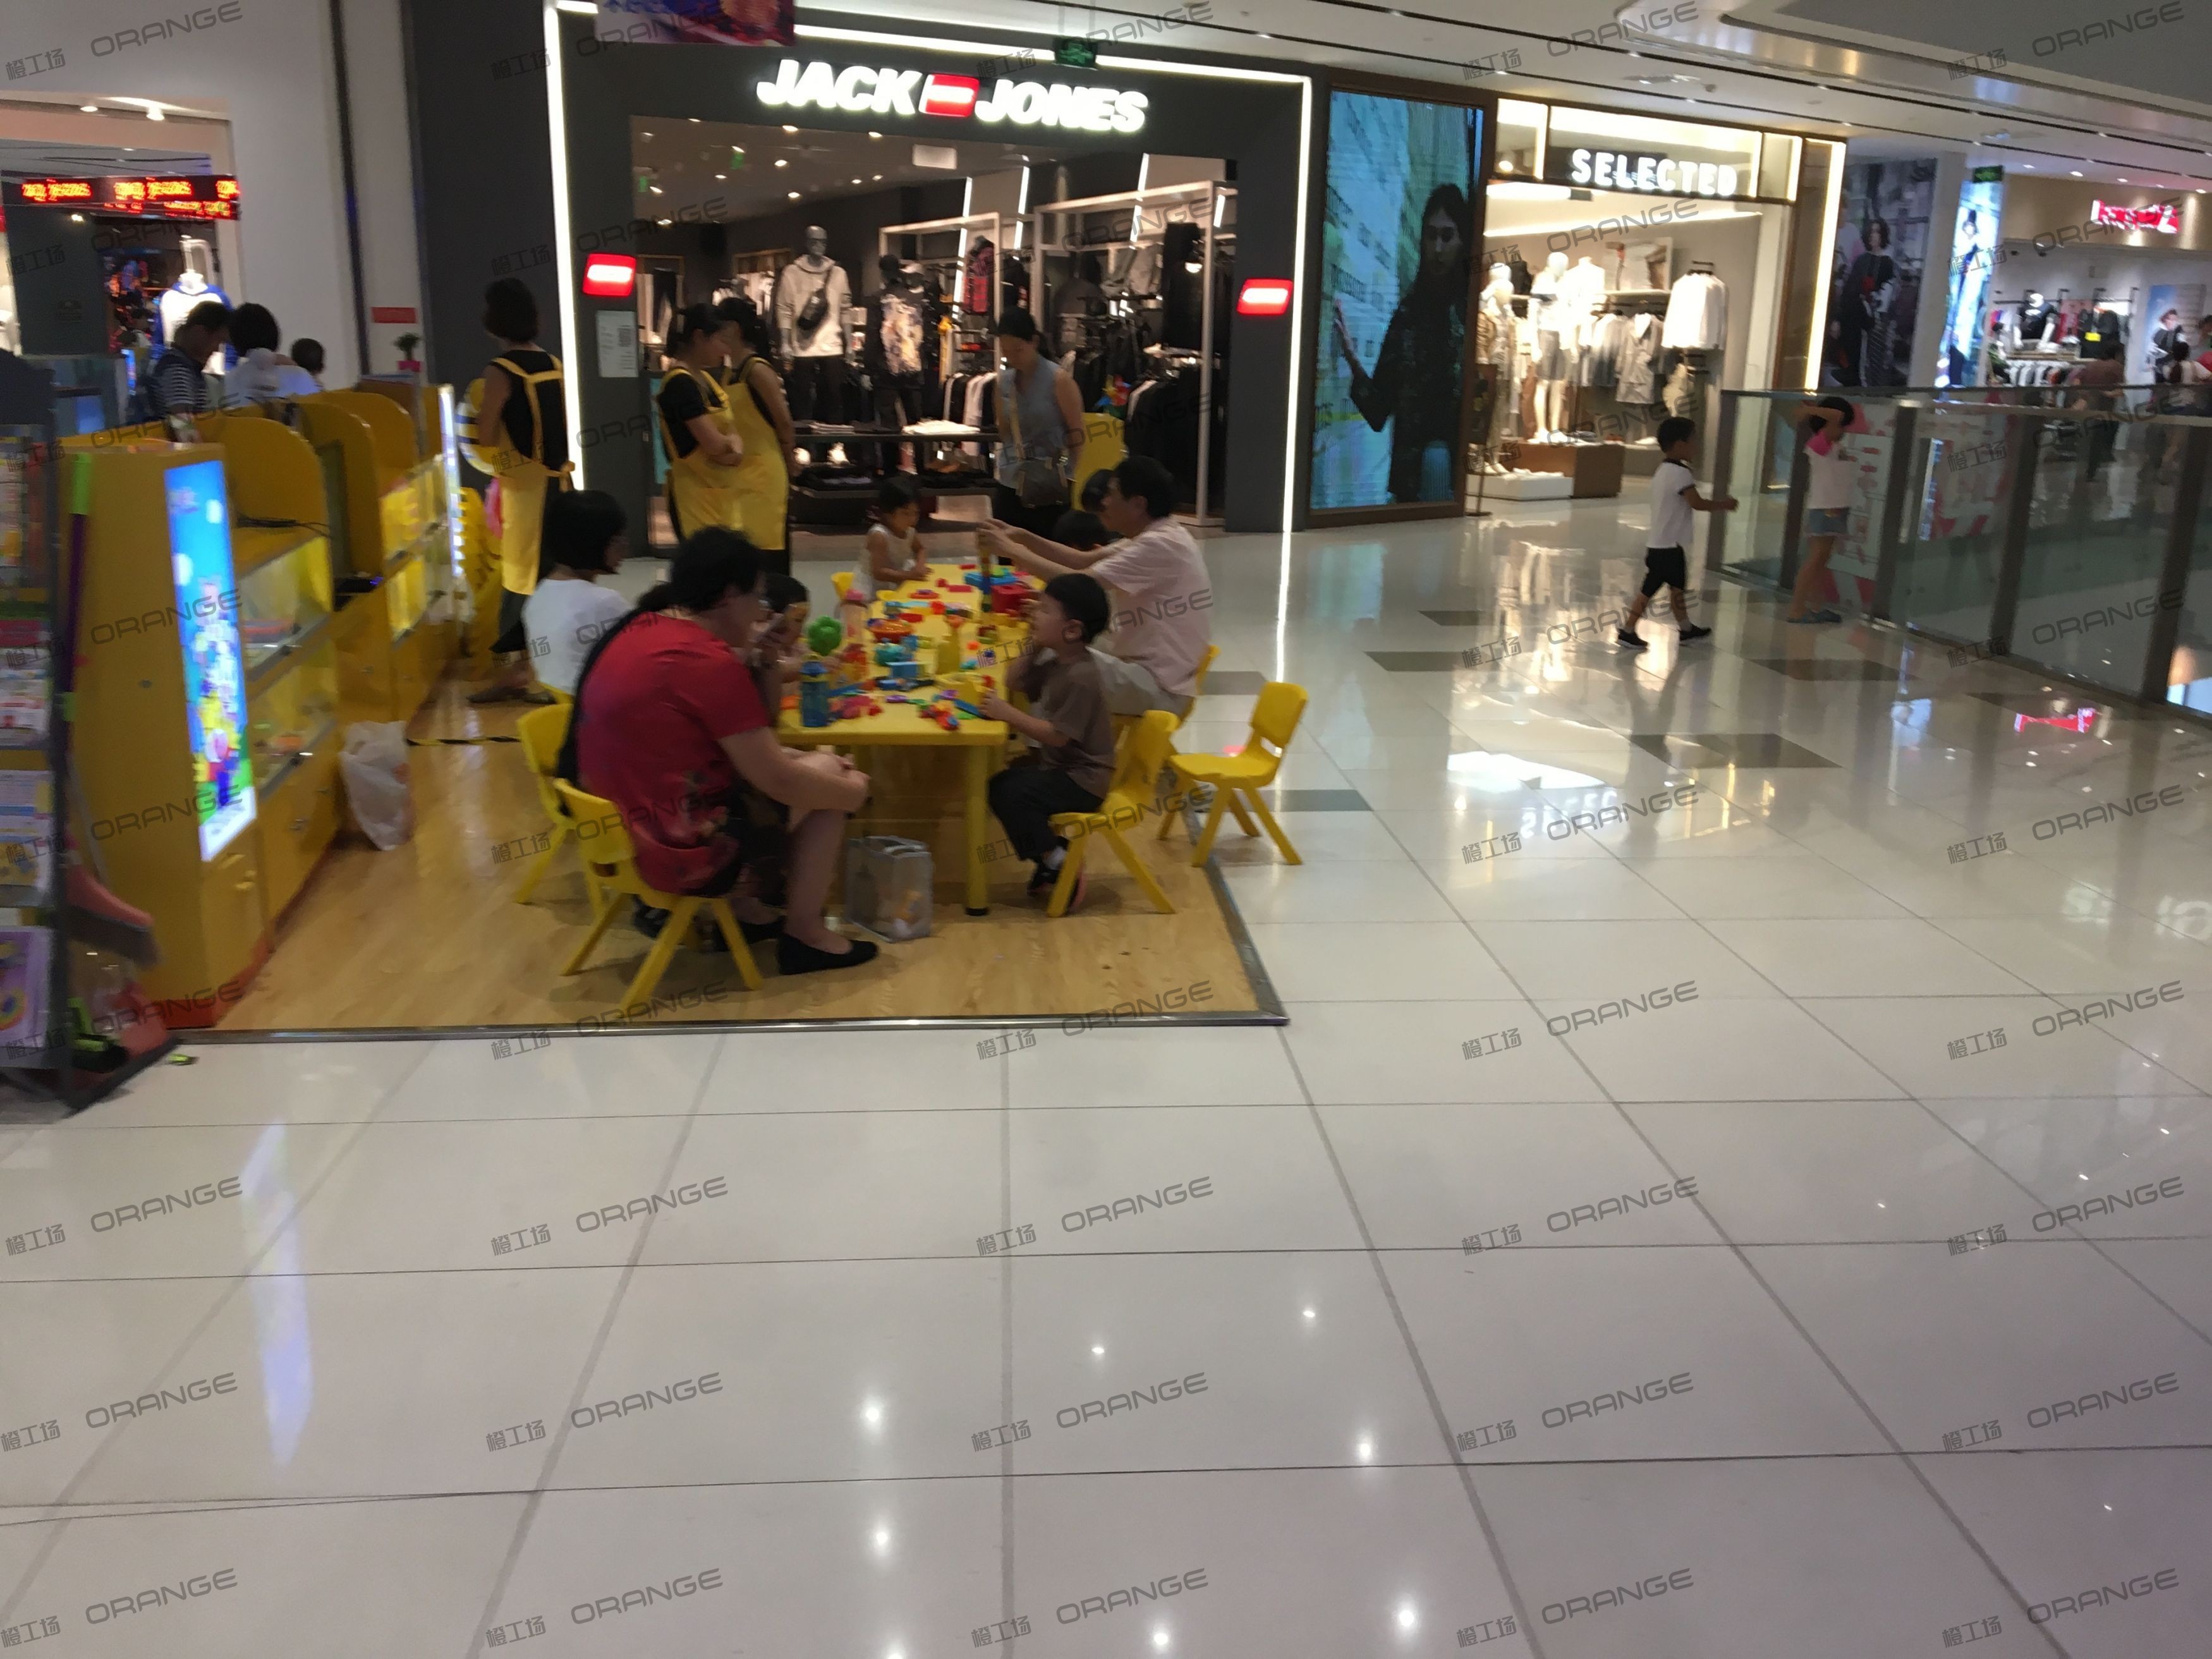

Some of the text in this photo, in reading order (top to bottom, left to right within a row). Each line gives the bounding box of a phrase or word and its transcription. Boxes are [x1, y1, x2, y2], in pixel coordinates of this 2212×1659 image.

[757, 59, 1148, 132] JACK JONES
[1571, 149, 1737, 196] SELECTED
